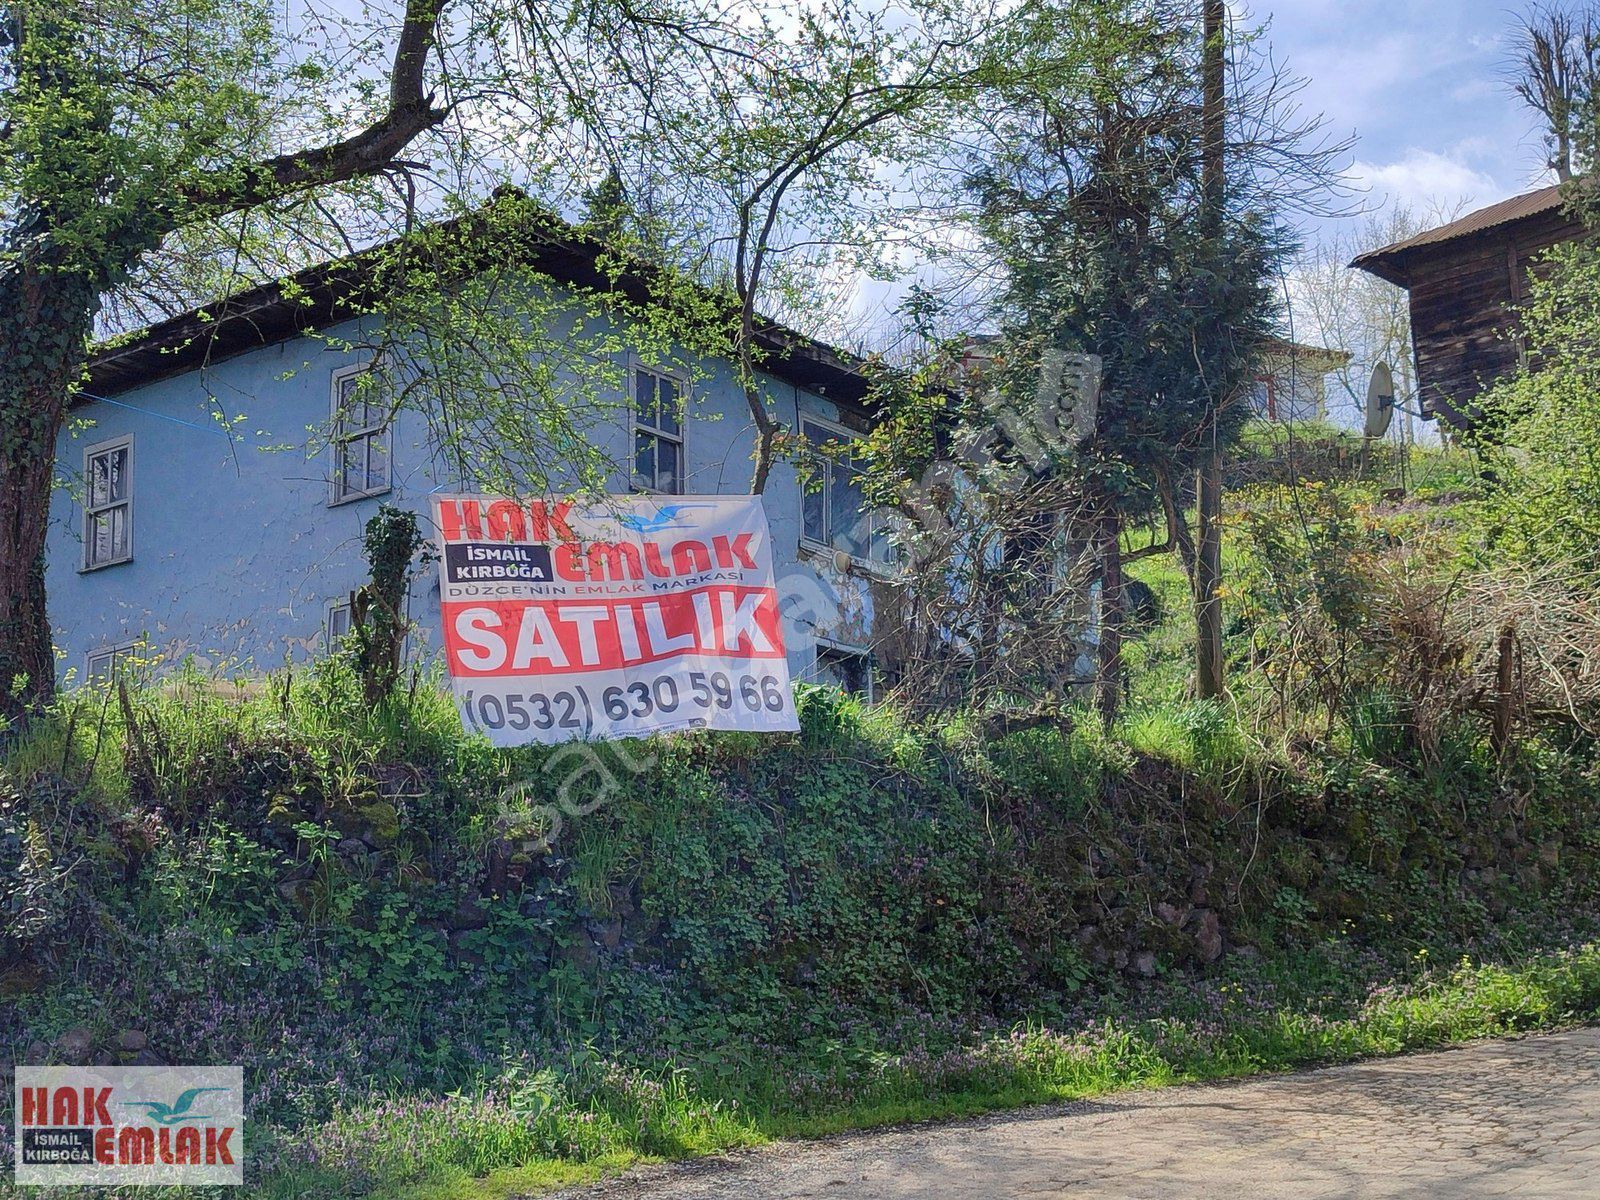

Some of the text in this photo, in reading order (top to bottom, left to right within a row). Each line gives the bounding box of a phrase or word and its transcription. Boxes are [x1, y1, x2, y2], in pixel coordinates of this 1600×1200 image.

[440, 499, 576, 542] HAK
[466, 546, 532, 562] İSMAİL
[449, 572, 744, 597] DÜZCE'NİN EMLAK MARKASI
[456, 563, 545, 580] KIRBOĞA
[455, 591, 776, 672] SATILIK
[465, 672, 784, 735] (0532) 630 59 66
